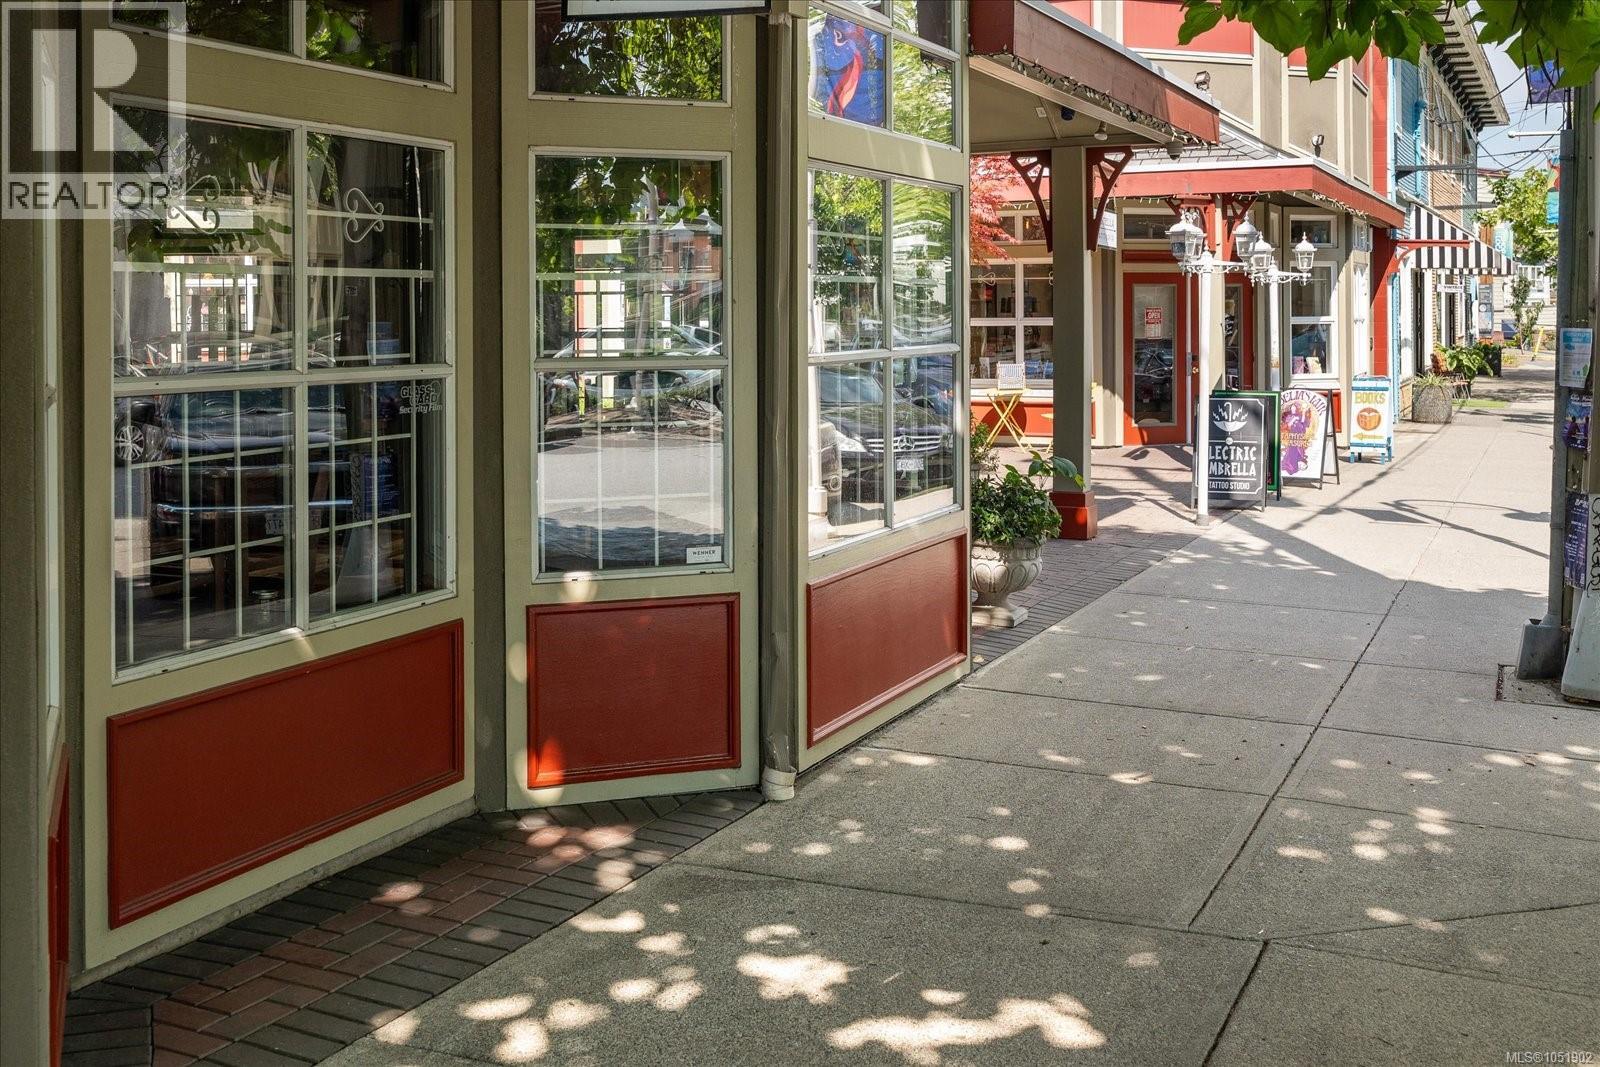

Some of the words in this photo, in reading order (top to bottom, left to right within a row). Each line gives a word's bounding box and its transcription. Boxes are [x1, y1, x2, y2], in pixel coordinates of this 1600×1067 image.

[1355, 392, 1385, 404] BOOKS
[1208, 446, 1257, 461] LECTRIC
[1208, 461, 1257, 476] MBRELLA
[1230, 482, 1250, 490] STUDIO
